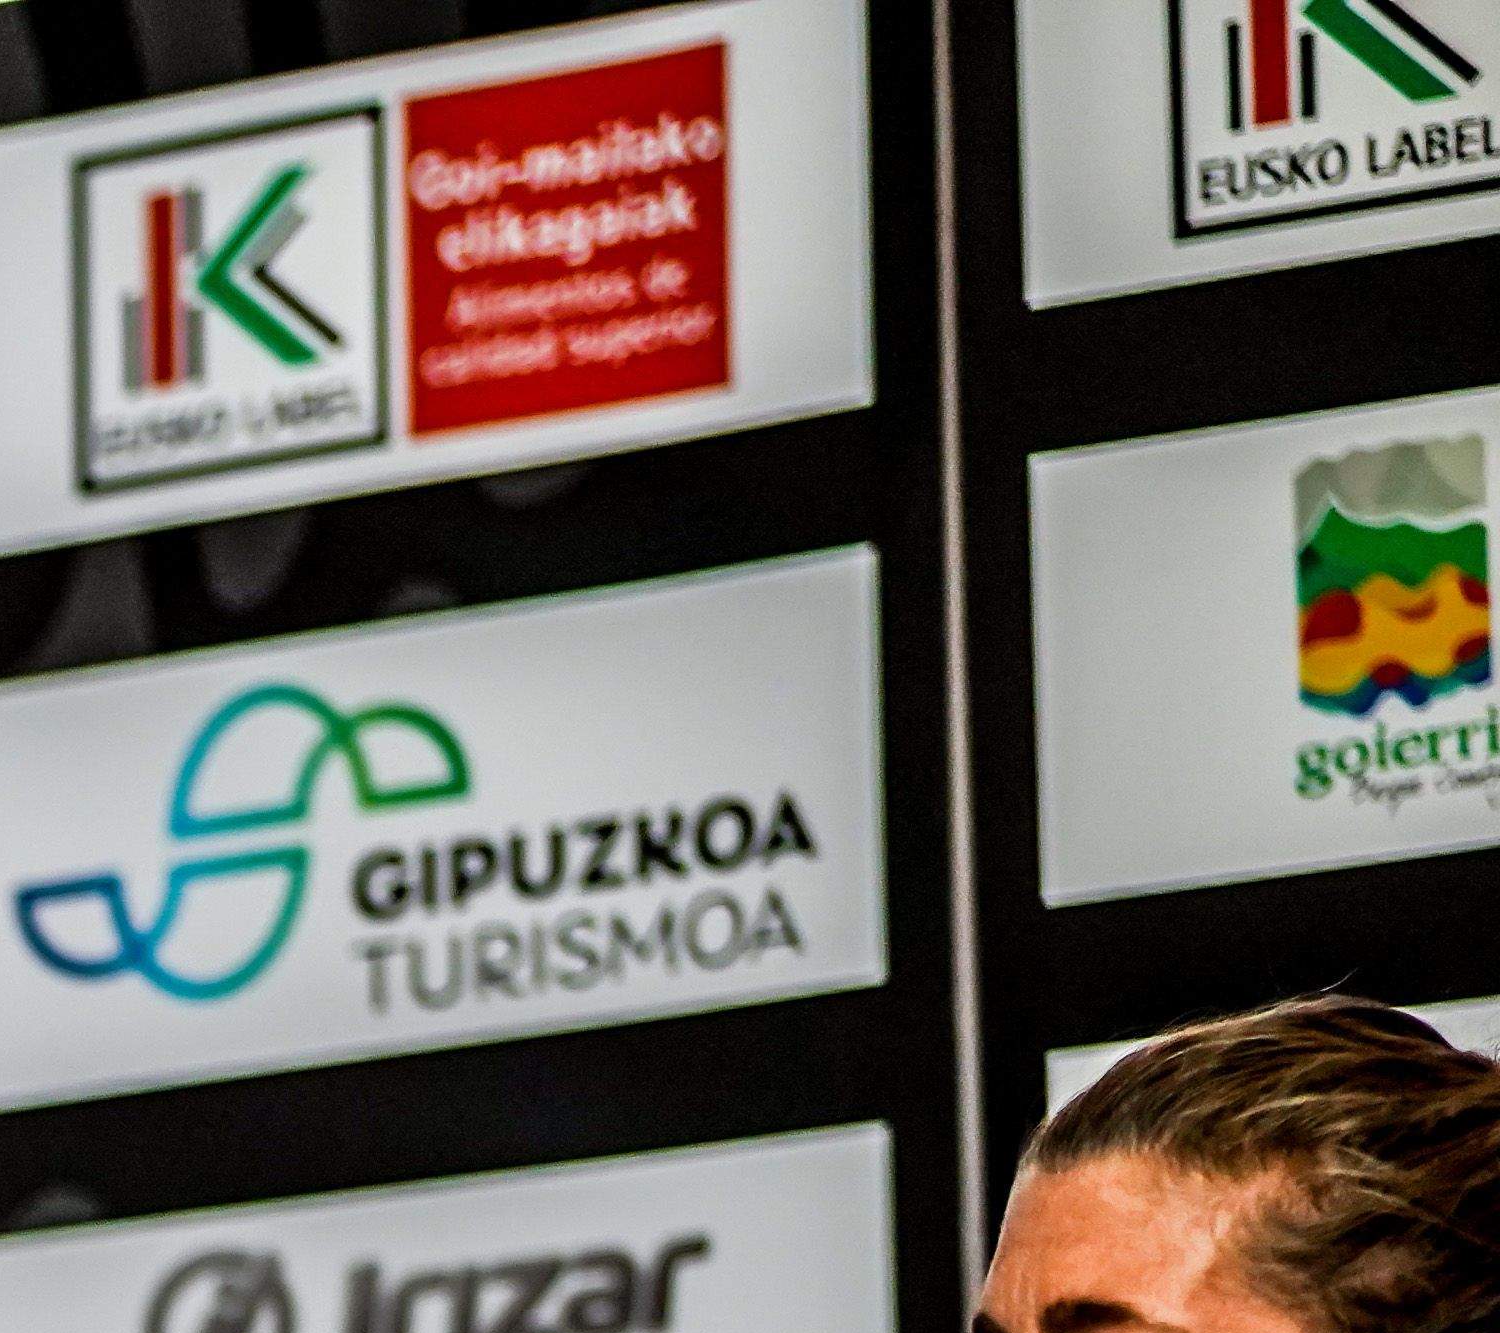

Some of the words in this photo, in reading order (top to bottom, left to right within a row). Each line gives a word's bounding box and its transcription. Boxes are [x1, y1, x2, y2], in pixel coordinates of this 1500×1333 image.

[1199, 138, 1350, 206] EUSKO
[351, 788, 819, 923] GIPUZKOA
[357, 886, 807, 1017] TURISMOA
